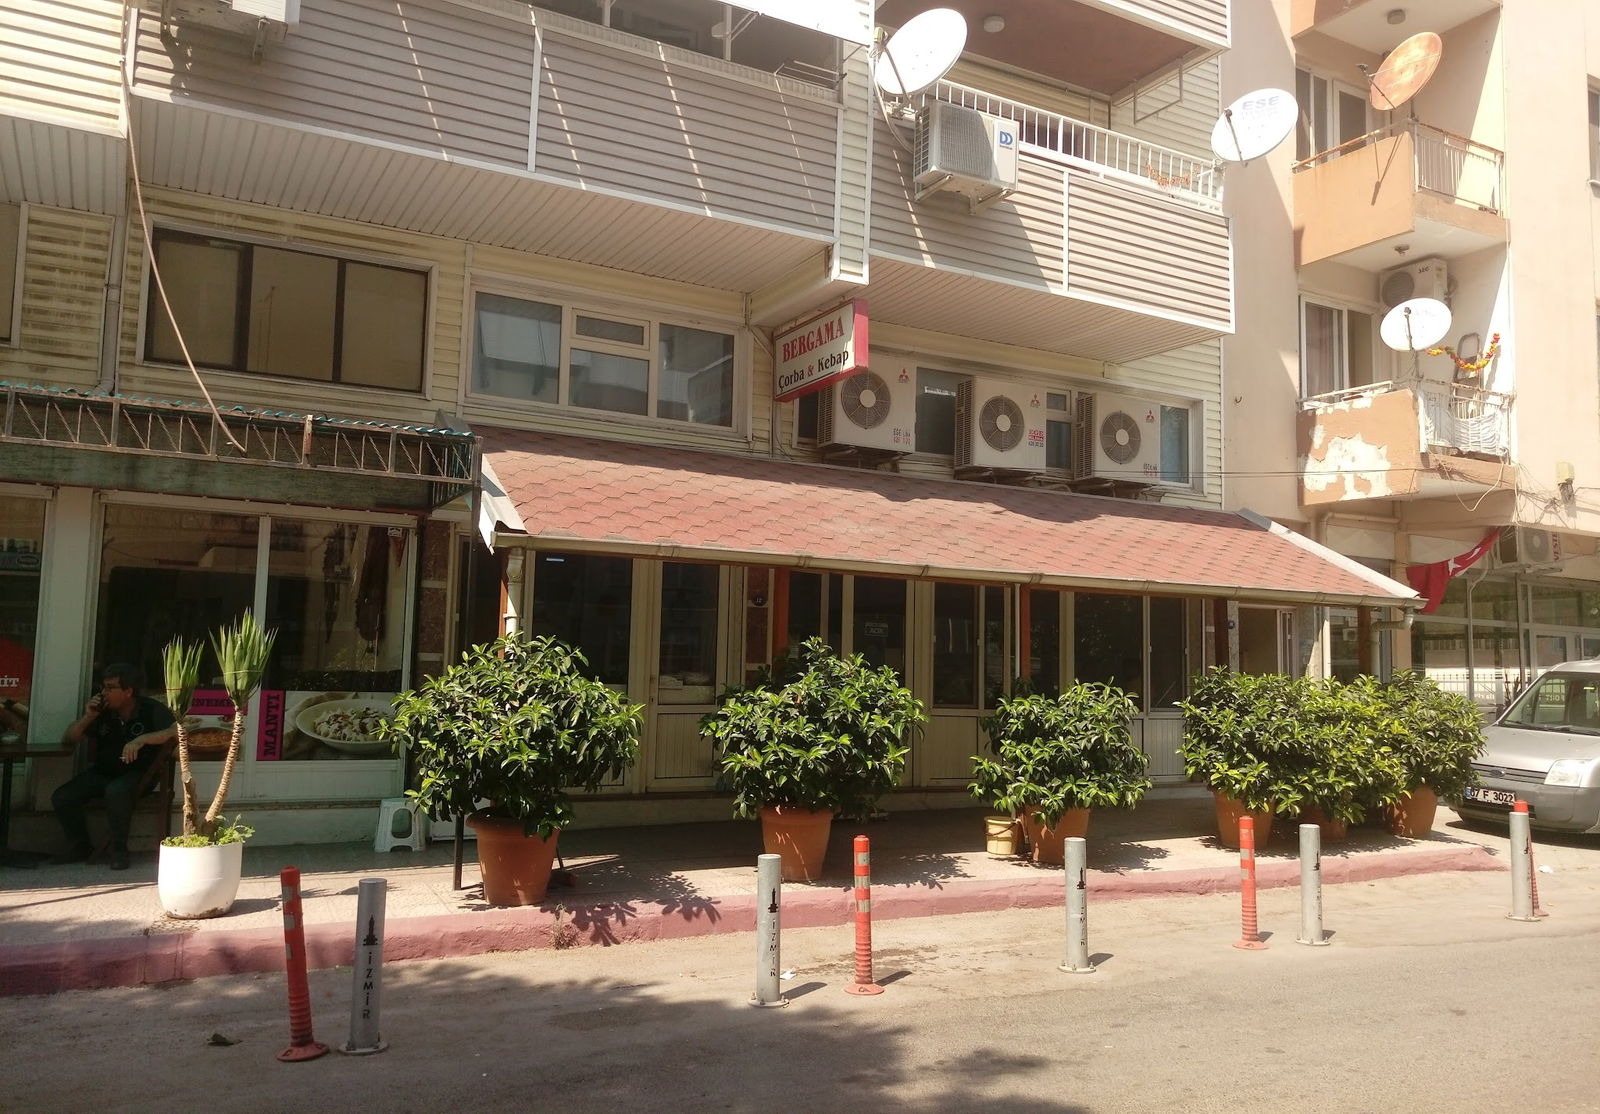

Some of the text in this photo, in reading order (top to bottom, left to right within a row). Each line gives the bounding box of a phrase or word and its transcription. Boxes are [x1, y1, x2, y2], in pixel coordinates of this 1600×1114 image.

[782, 315, 845, 364] BERGAMA
[778, 350, 849, 392] Çorba & Kebap
[263, 694, 280, 757] MANTI
[1493, 791, 1514, 803] 3022
[362, 951, 374, 1020] İZMİR
